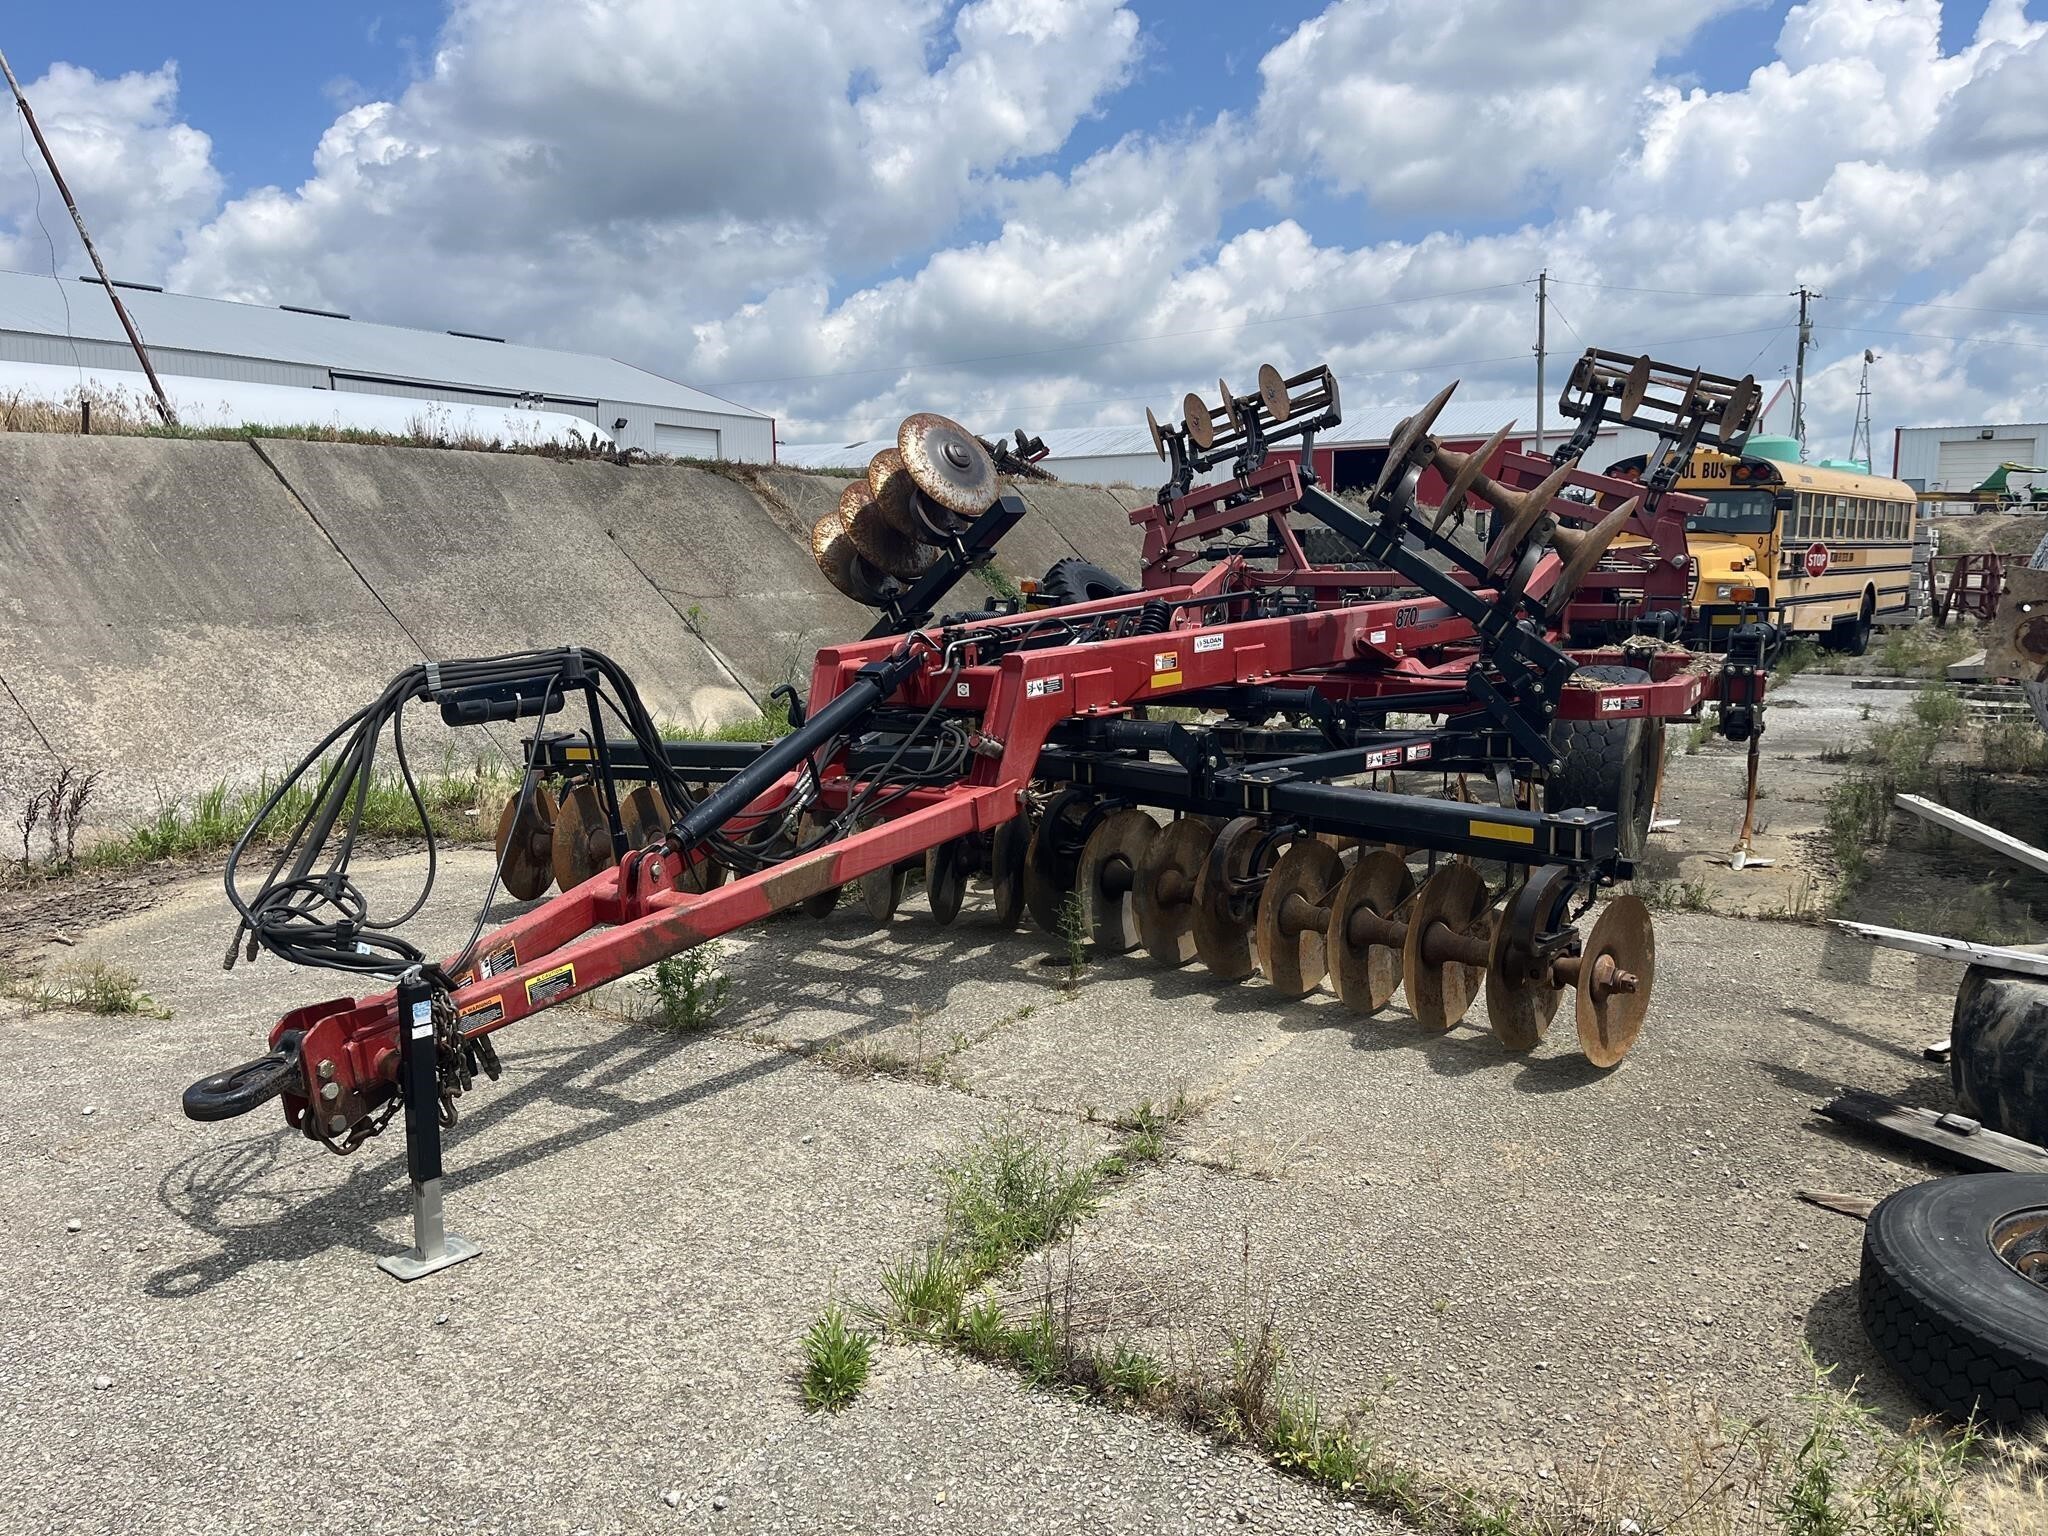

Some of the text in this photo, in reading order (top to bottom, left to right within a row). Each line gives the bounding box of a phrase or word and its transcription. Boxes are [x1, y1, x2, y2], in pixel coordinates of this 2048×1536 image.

[1702, 462, 1727, 479] BUS
[1757, 536, 1764, 549] 9
[1808, 554, 1826, 566] STOP
[1396, 606, 1418, 629] 870
[1203, 637, 1222, 645] SLOAN
[542, 968, 563, 979] CAUTION
[467, 1000, 492, 1012] WARNING
